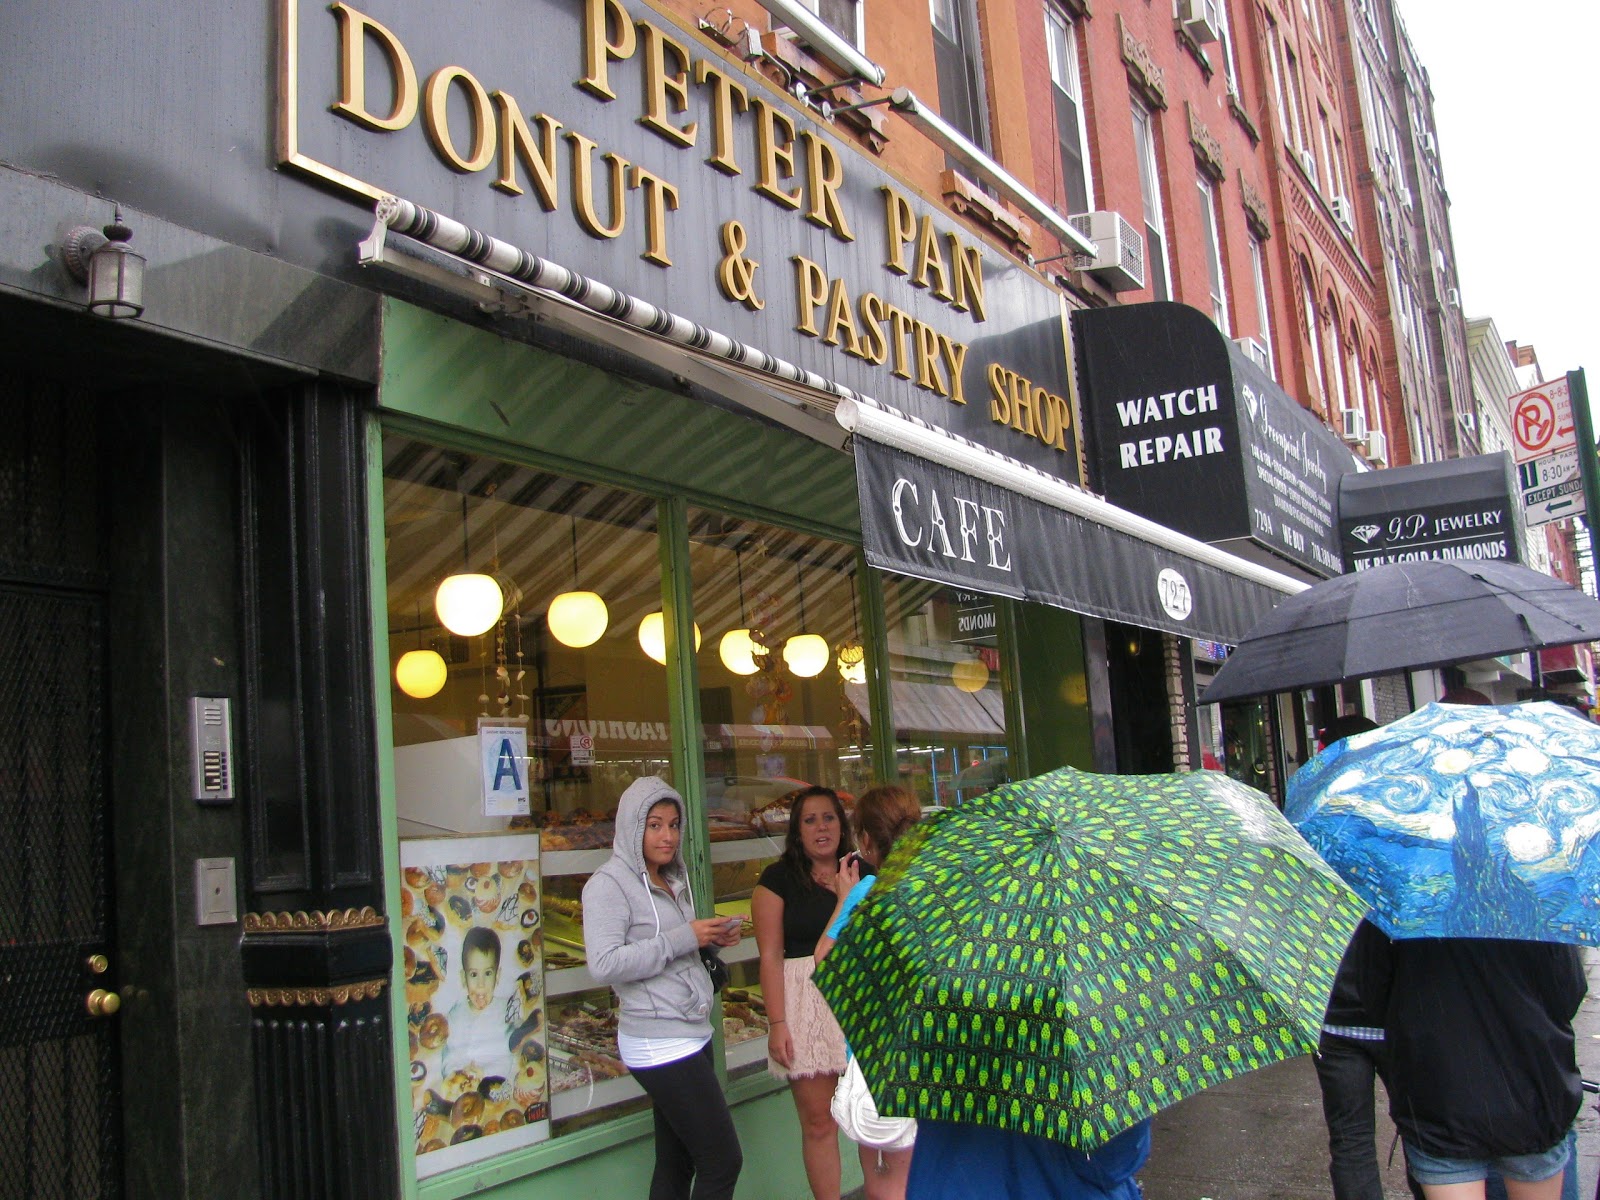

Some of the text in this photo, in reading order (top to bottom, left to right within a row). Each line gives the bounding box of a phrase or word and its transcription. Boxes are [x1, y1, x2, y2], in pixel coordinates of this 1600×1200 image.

[578, 0, 986, 322] PETER PAN
[331, 1, 1071, 452] DONUT & PASTRY SHOP
[1115, 384, 1218, 427] WATCH
[1118, 427, 1224, 469] REPAIR
[1528, 487, 1556, 505] EXCEPT
[891, 478, 1012, 572] CAFE
[1254, 508, 1274, 536] 729A
[1434, 510, 1502, 536] JEWELRY
[1442, 540, 1507, 561] DIAMONDS
[1161, 577, 1188, 613] 727
[493, 738, 522, 791] A
